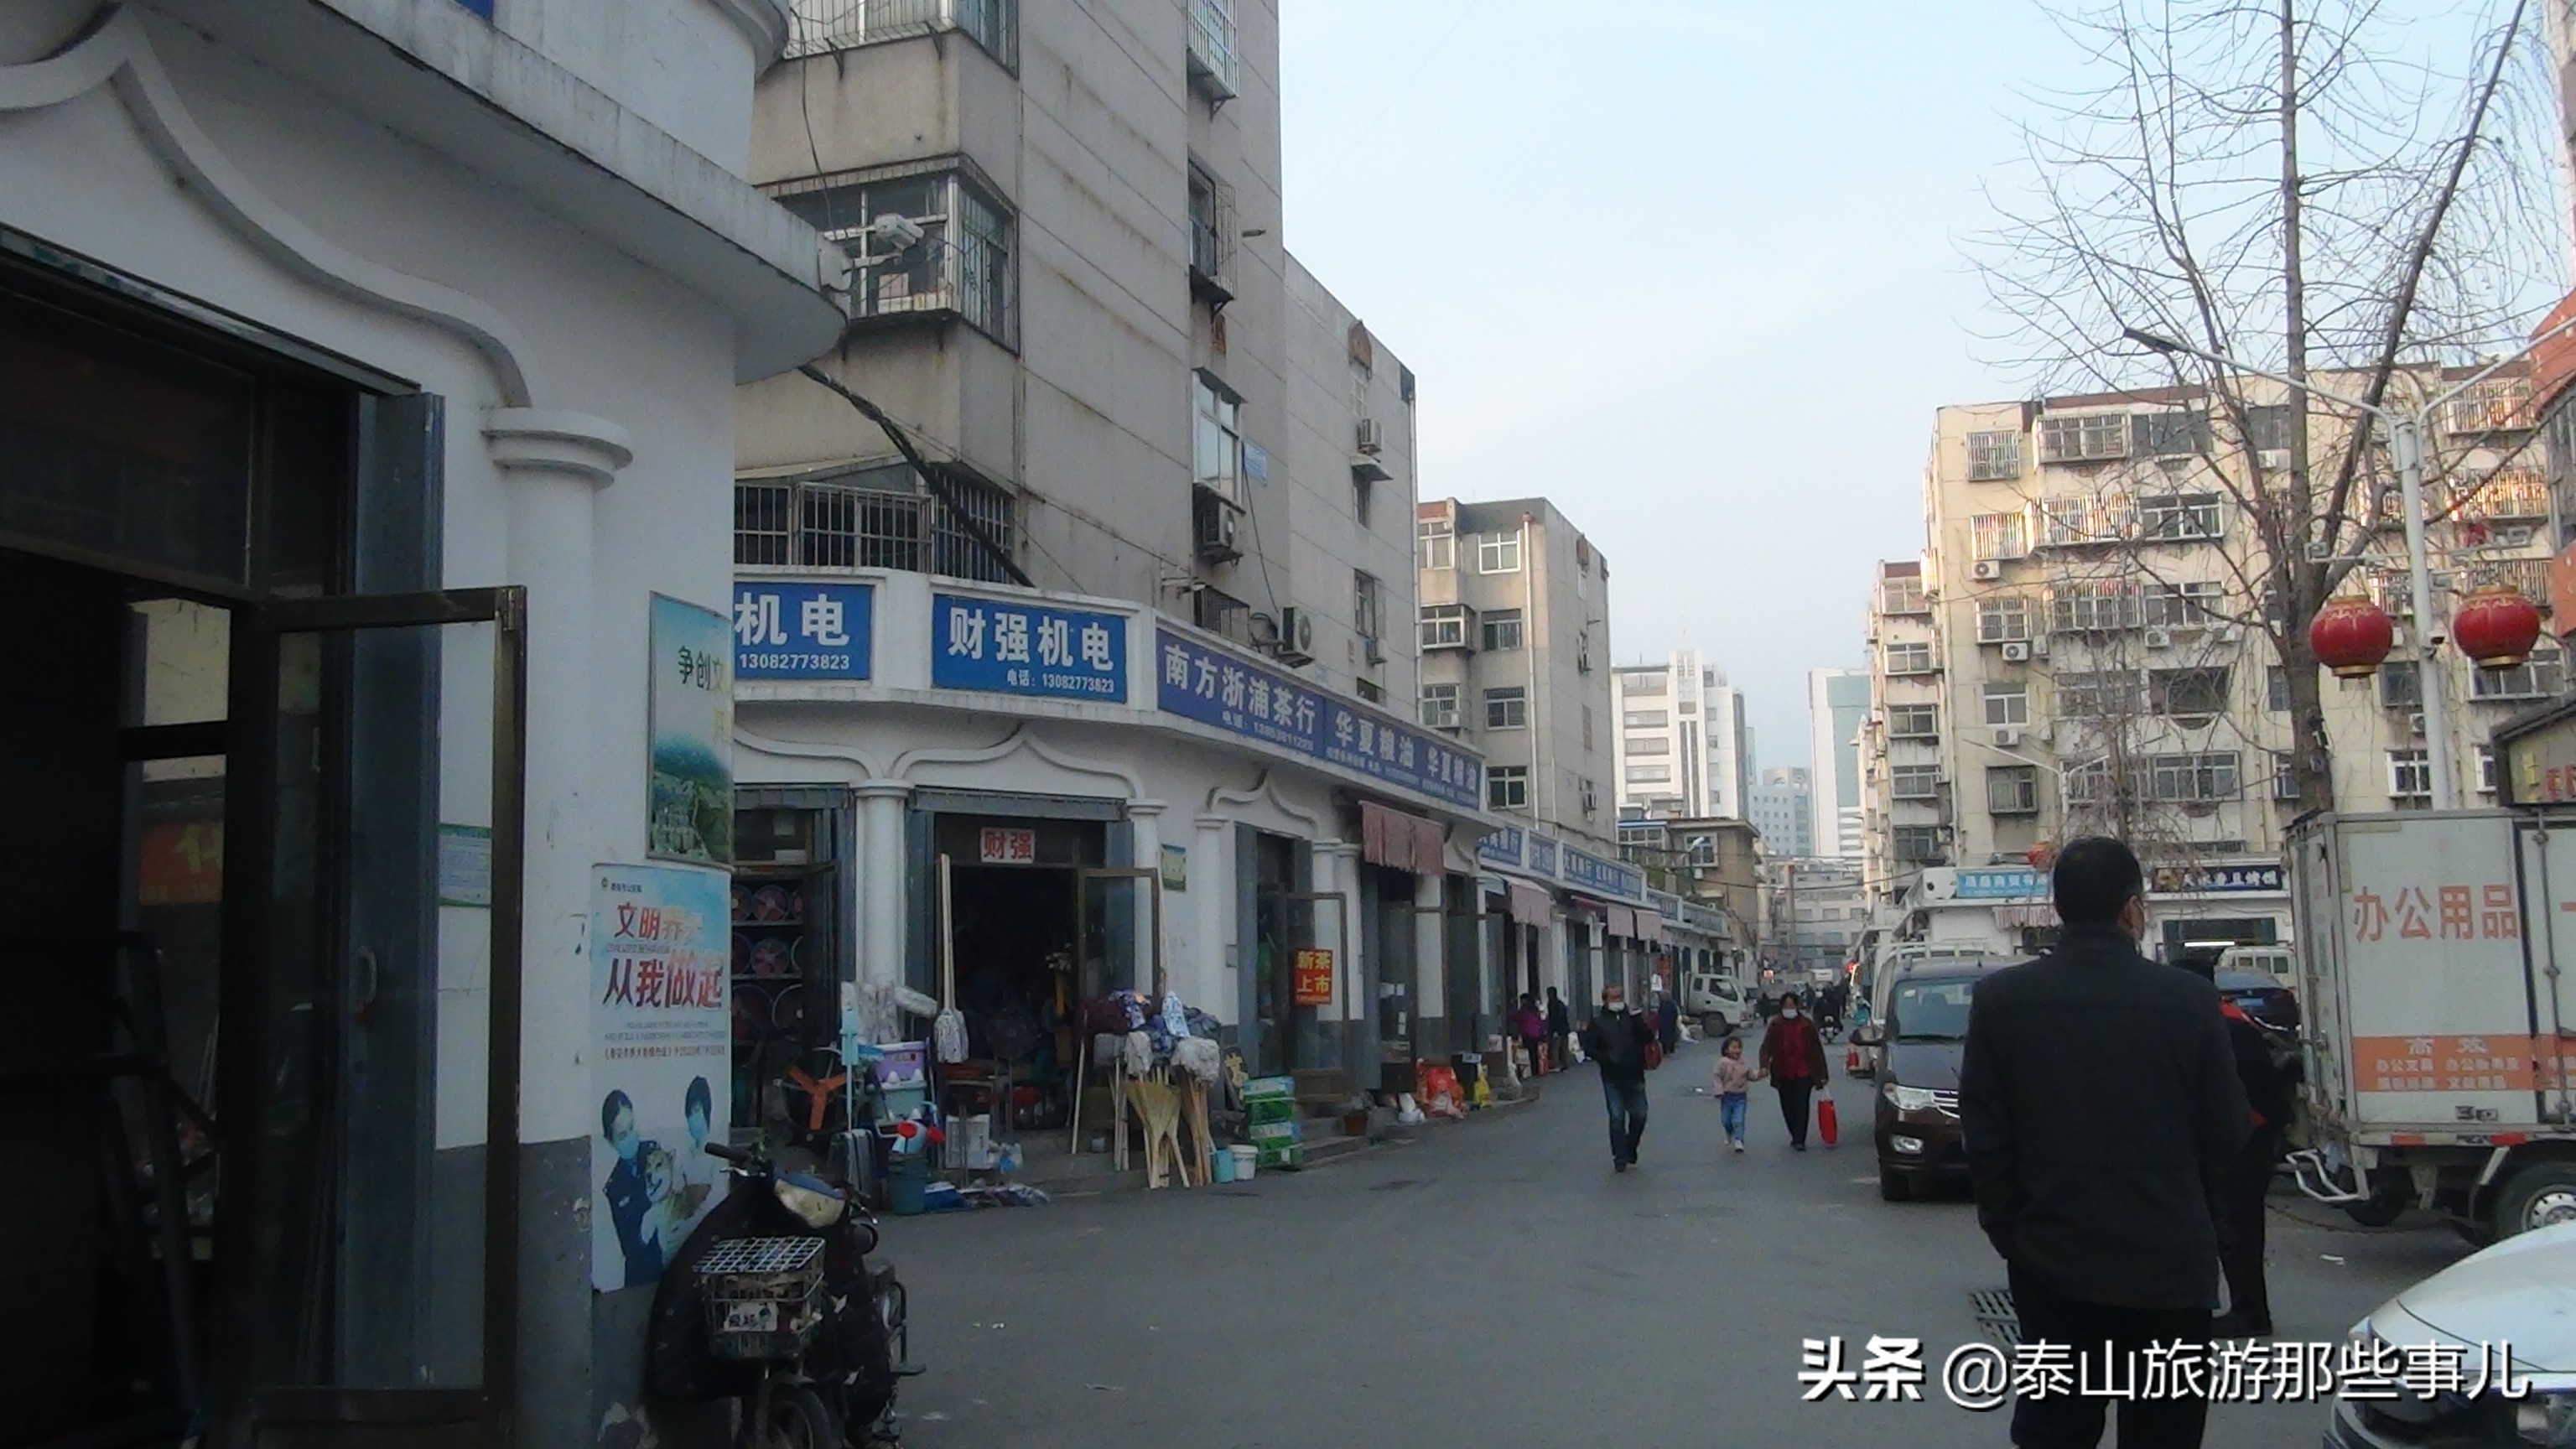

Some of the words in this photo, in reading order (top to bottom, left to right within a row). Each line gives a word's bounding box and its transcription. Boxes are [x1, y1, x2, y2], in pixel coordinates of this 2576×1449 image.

[735, 592, 849, 647] 机电
[948, 606, 1114, 671] 财强机电
[740, 653, 849, 670] 13082773823
[1164, 644, 1317, 735] 南方浙浦茶行
[983, 830, 1032, 860] 财强
[2353, 883, 2519, 942] 办公用品
[602, 953, 724, 1009] 从我做起
[1296, 974, 1332, 995] 上市
